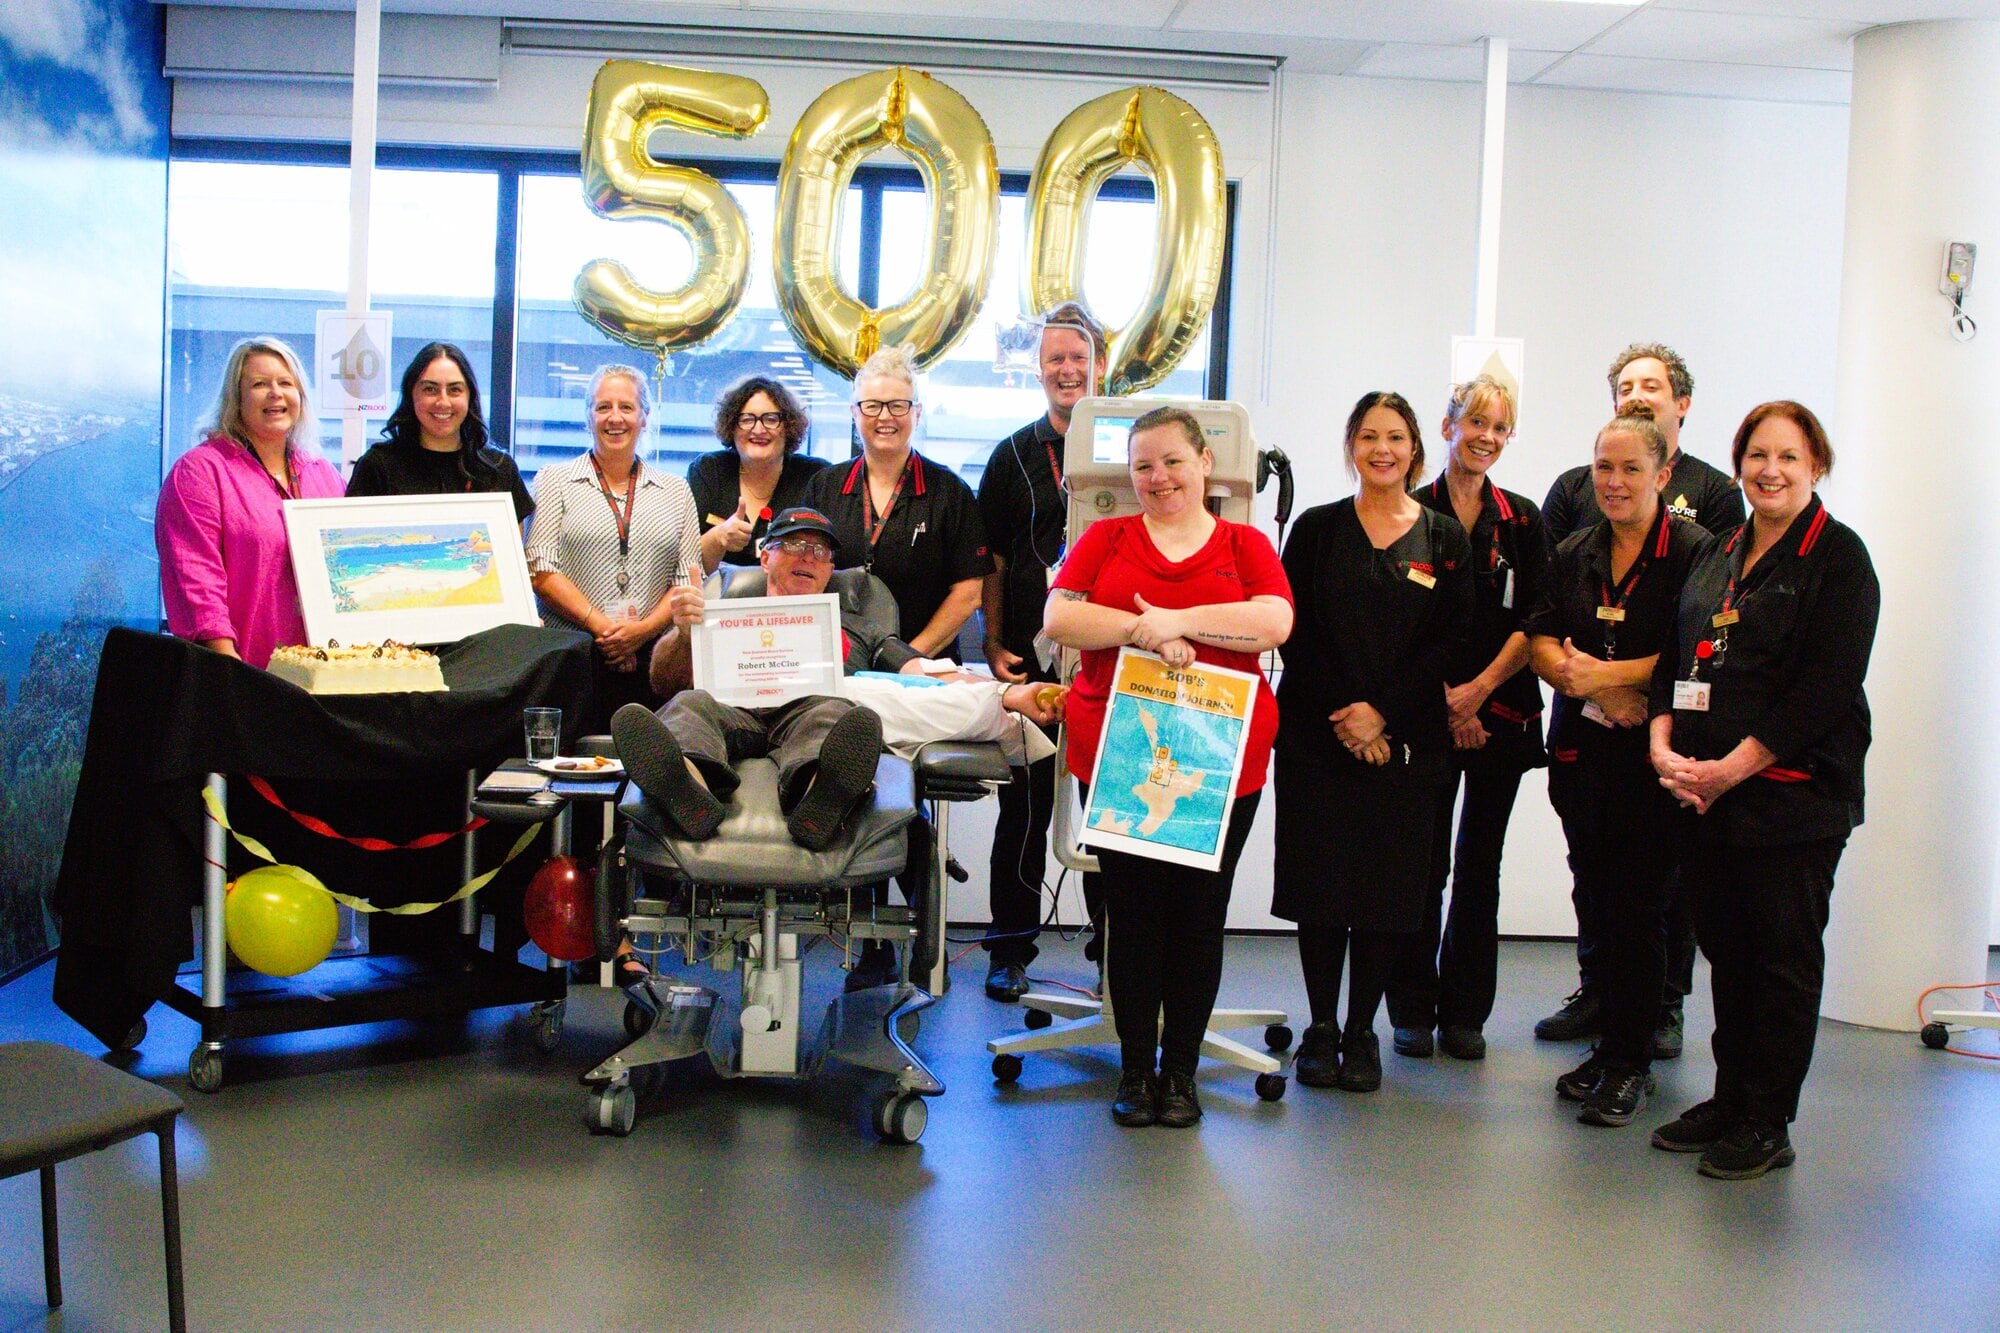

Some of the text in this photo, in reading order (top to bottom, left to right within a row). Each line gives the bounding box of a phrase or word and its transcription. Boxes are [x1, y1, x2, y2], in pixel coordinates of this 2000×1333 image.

[572, 58, 1227, 398] 500
[330, 348, 380, 381] 10
[719, 616, 814, 628] YOU'RE A LIFESAVER
[737, 660, 800, 670] Robert McClue
[1166, 670, 1206, 687] ROB'S
[1186, 693, 1234, 711] JOURN
